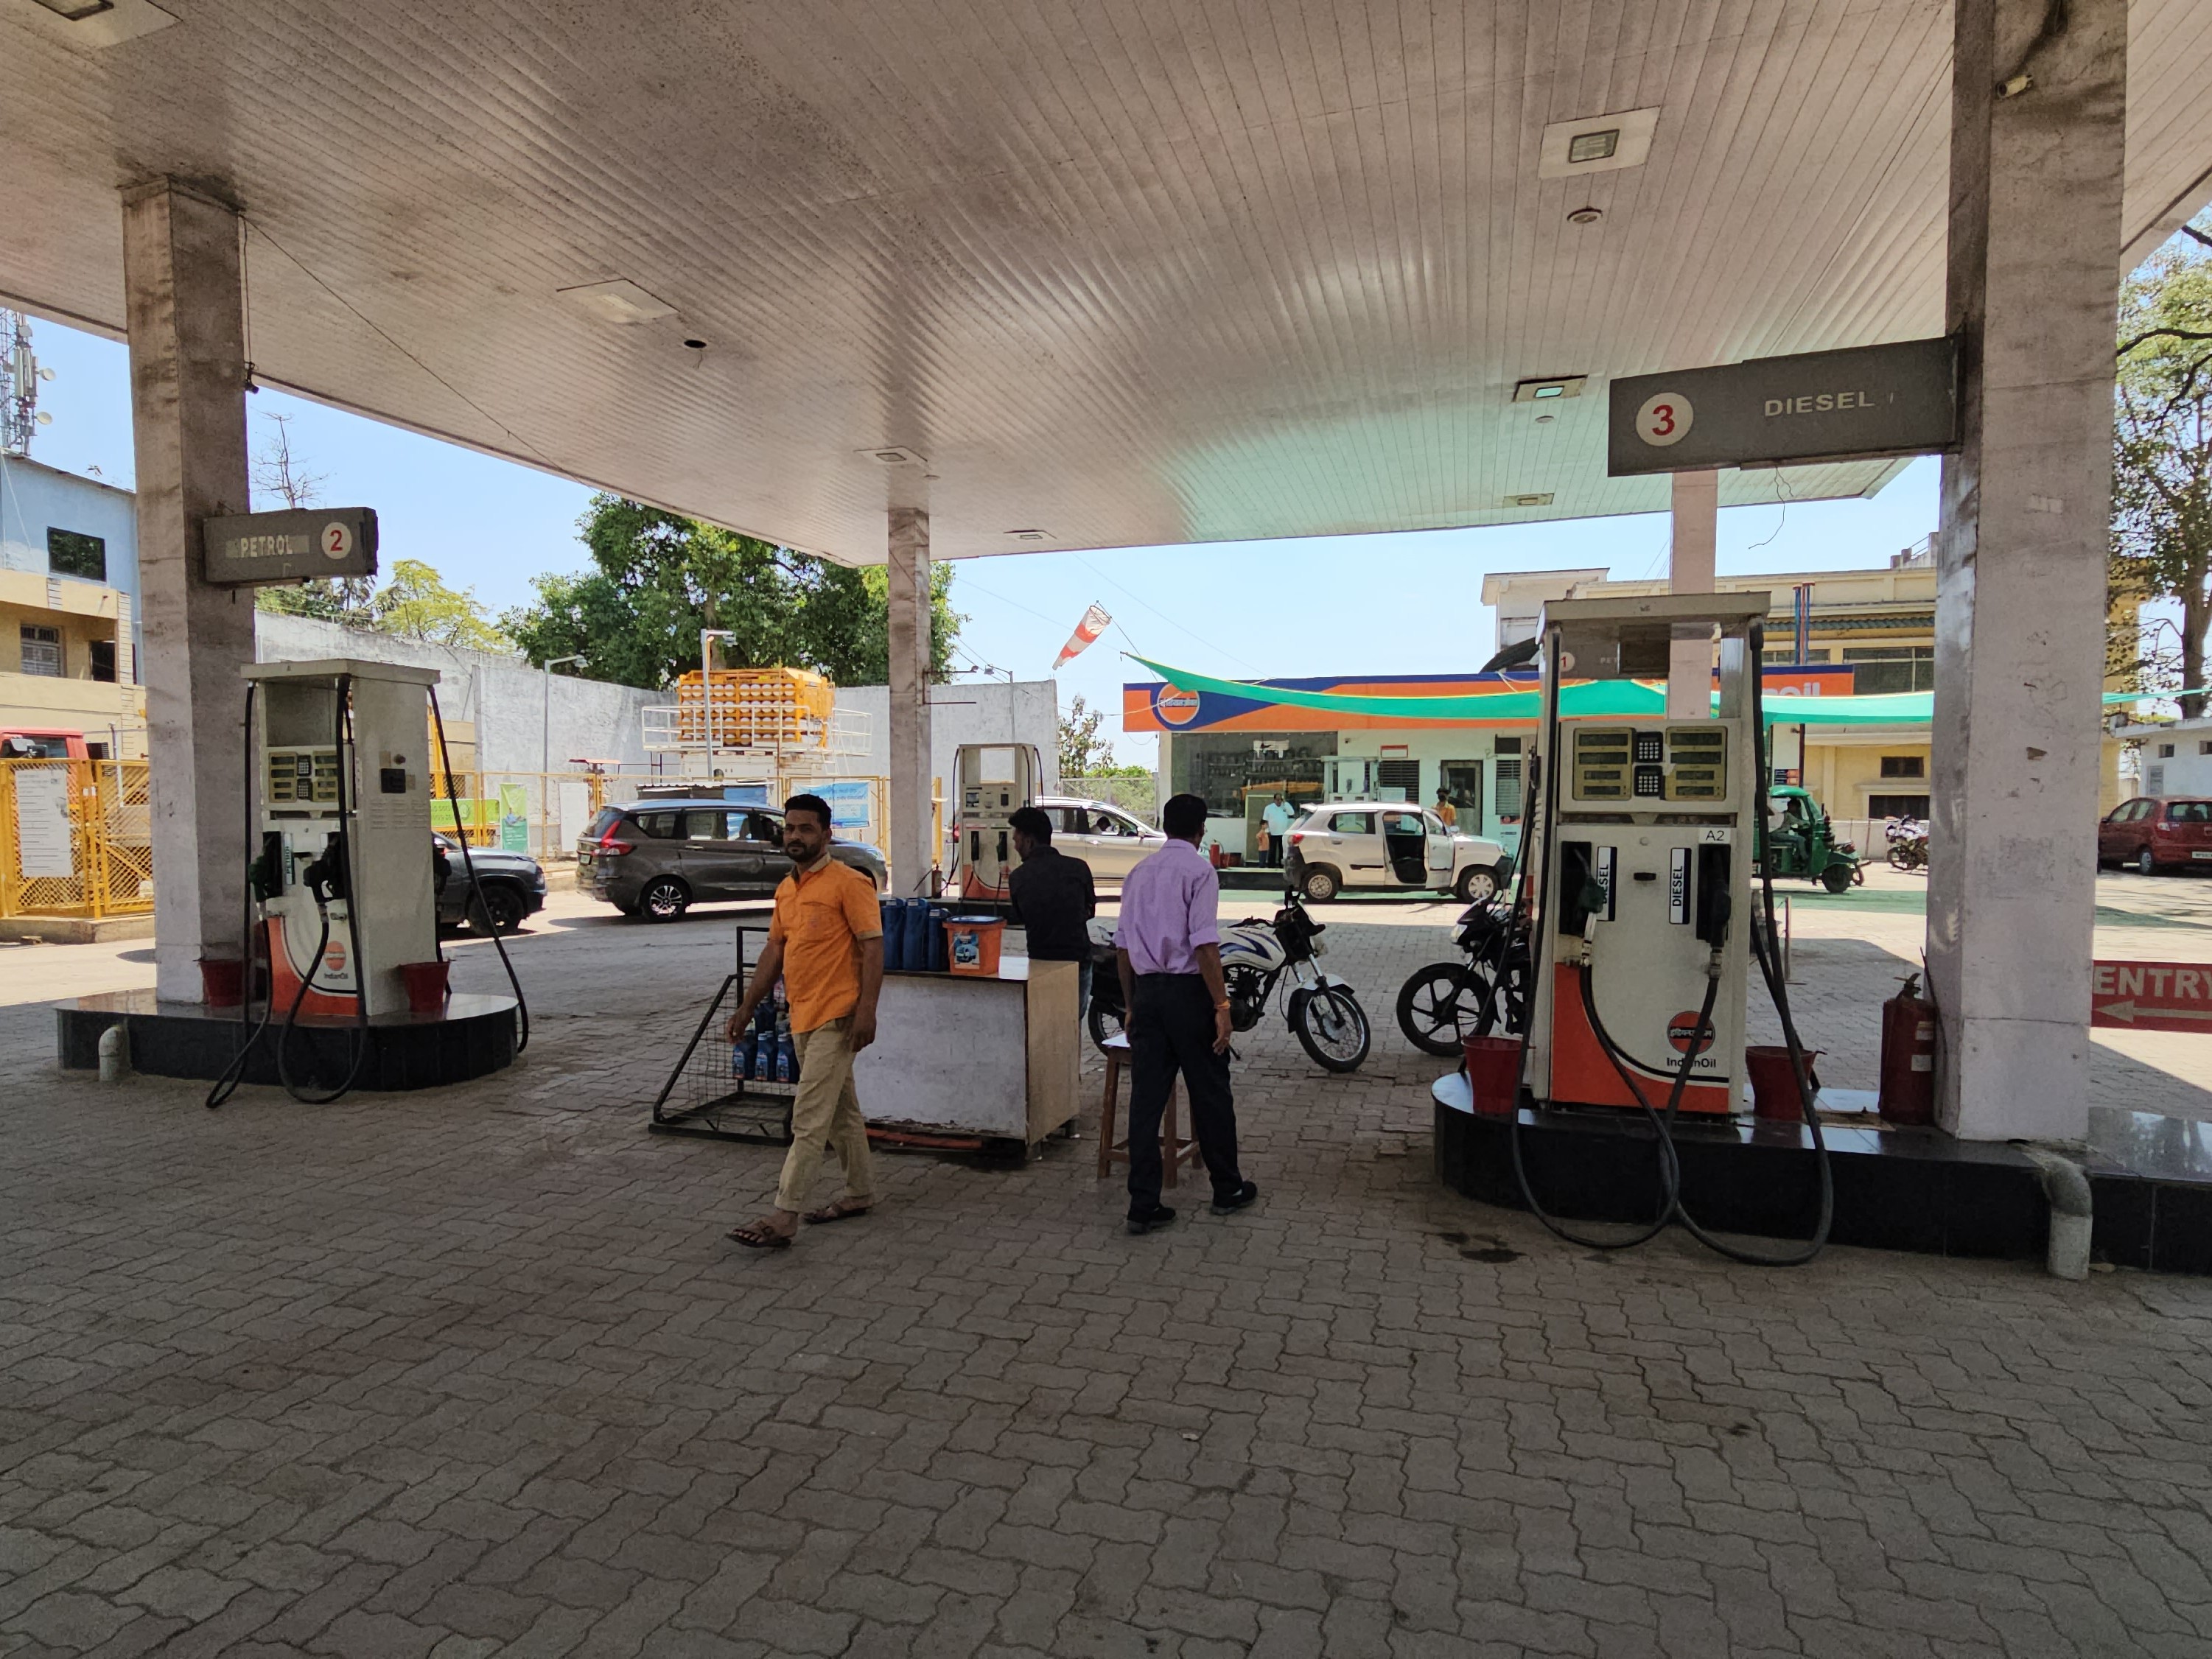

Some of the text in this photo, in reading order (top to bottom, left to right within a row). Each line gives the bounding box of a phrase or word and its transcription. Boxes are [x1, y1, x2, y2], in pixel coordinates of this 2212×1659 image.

[1651, 391, 1876, 436] 3 DIESEL
[240, 530, 343, 558] PETROL 2
[1560, 656, 1567, 668] 1
[1705, 830, 1725, 842] A2
[1672, 865, 1684, 908] DIESEL
[2092, 966, 2212, 1000] ENTRY
[1667, 1057, 1717, 1068] IndnOil
